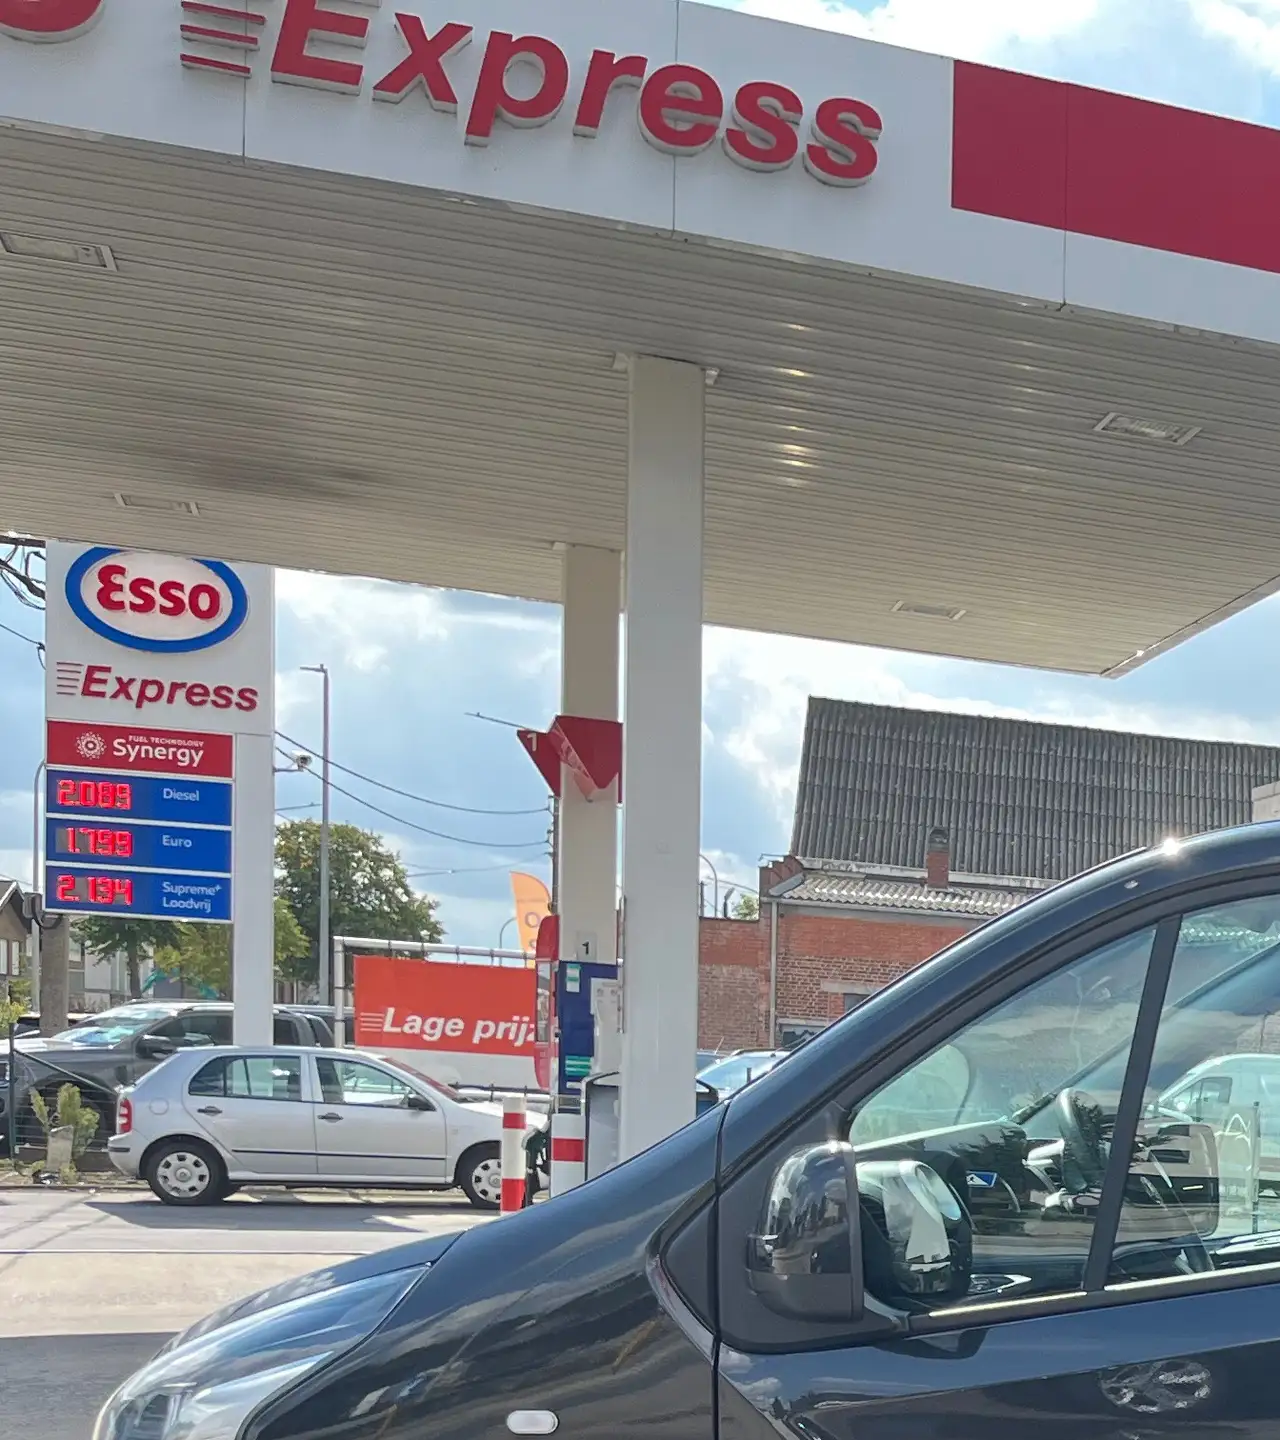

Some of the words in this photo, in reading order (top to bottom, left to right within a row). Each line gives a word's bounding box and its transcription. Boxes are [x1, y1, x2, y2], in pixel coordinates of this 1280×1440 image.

[270, 0, 883, 188] Express
[96, 563, 221, 621] Esso
[80, 664, 259, 713] Express
[112, 738, 204, 767] Synergy
[128, 735, 148, 743] FUEL
[150, 738, 204, 748] TECHNOLOGY
[162, 788, 200, 801] Diesel
[162, 834, 193, 848] Euro
[56, 874, 133, 906] 2.134
[162, 896, 212, 914] Loodvrij
[383, 1007, 464, 1042] Lage
